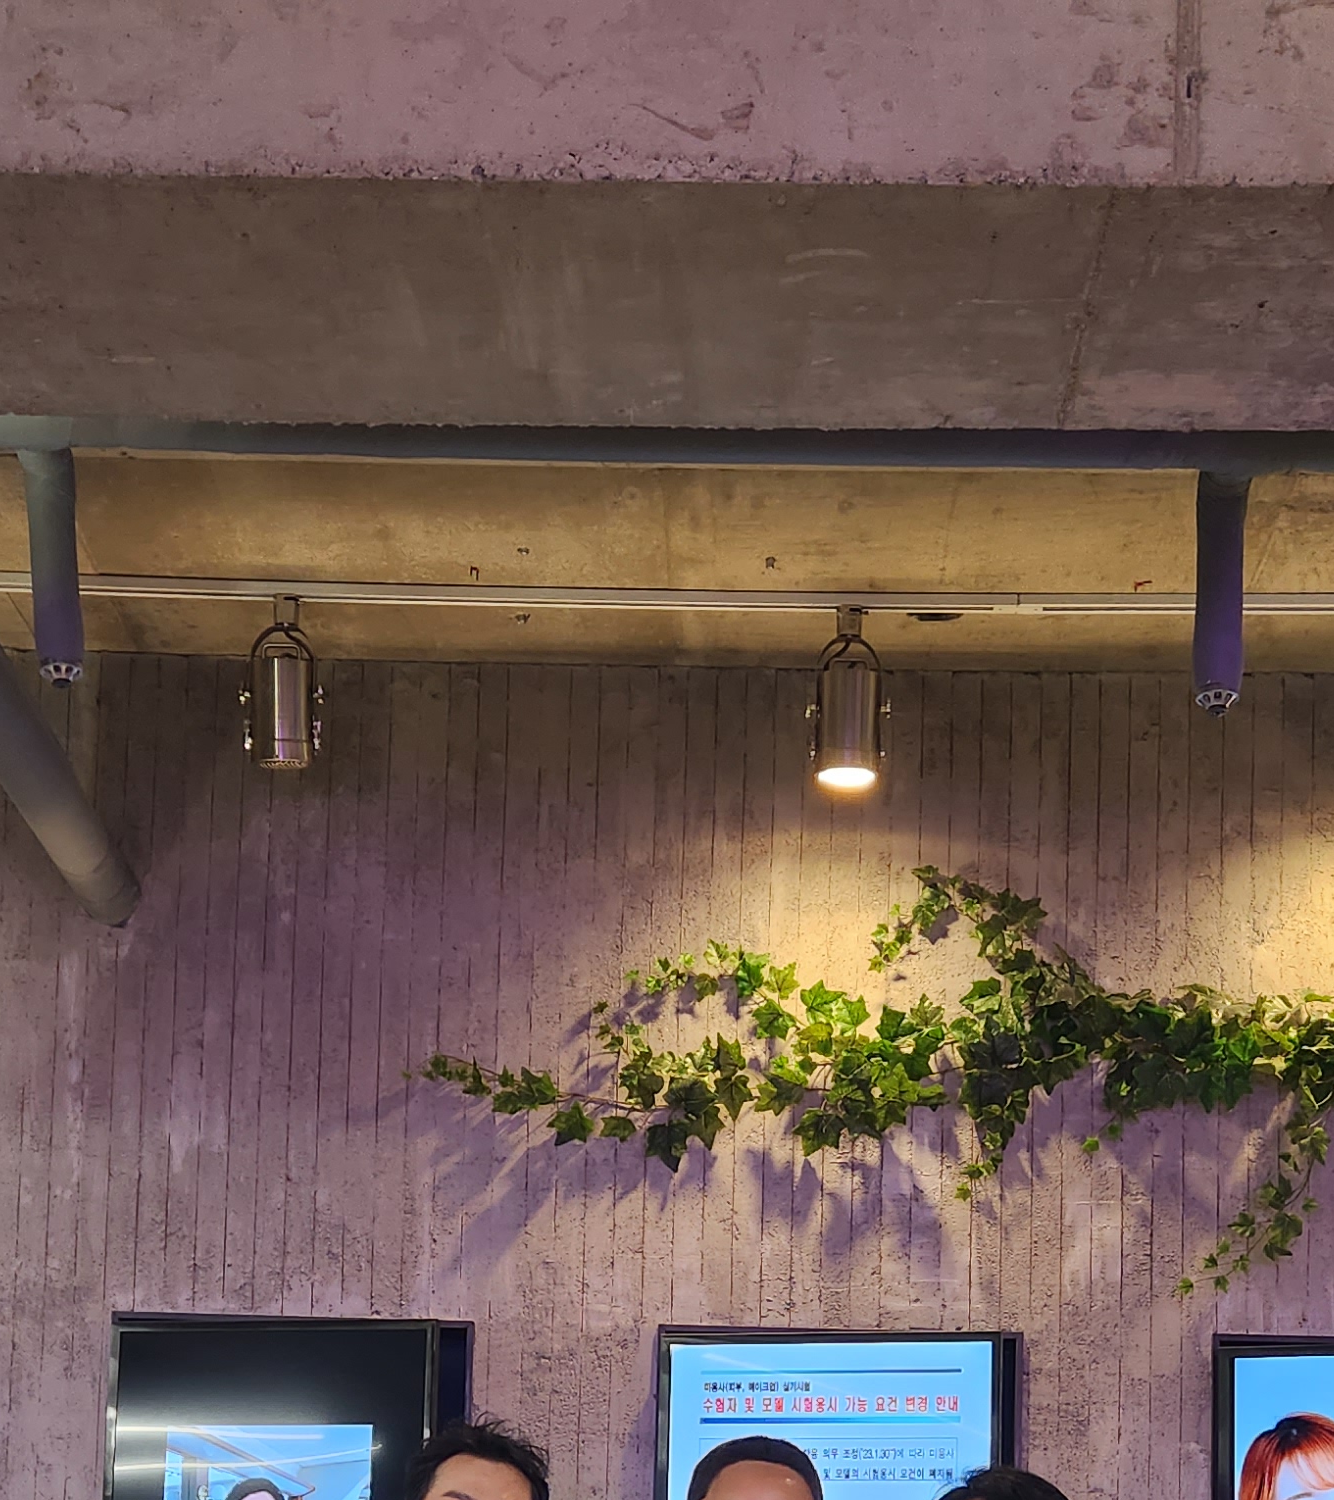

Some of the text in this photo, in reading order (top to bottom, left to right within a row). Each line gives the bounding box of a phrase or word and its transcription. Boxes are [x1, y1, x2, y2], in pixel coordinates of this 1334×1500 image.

[703, 1396, 737, 1413] 수험자
[745, 1396, 754, 1413] 및
[762, 1396, 784, 1413] 모델
[845, 1396, 868, 1413] 가능
[875, 1396, 898, 1413] 요건
[905, 1396, 928, 1413] 변경
[935, 1395, 959, 1412] 안내
